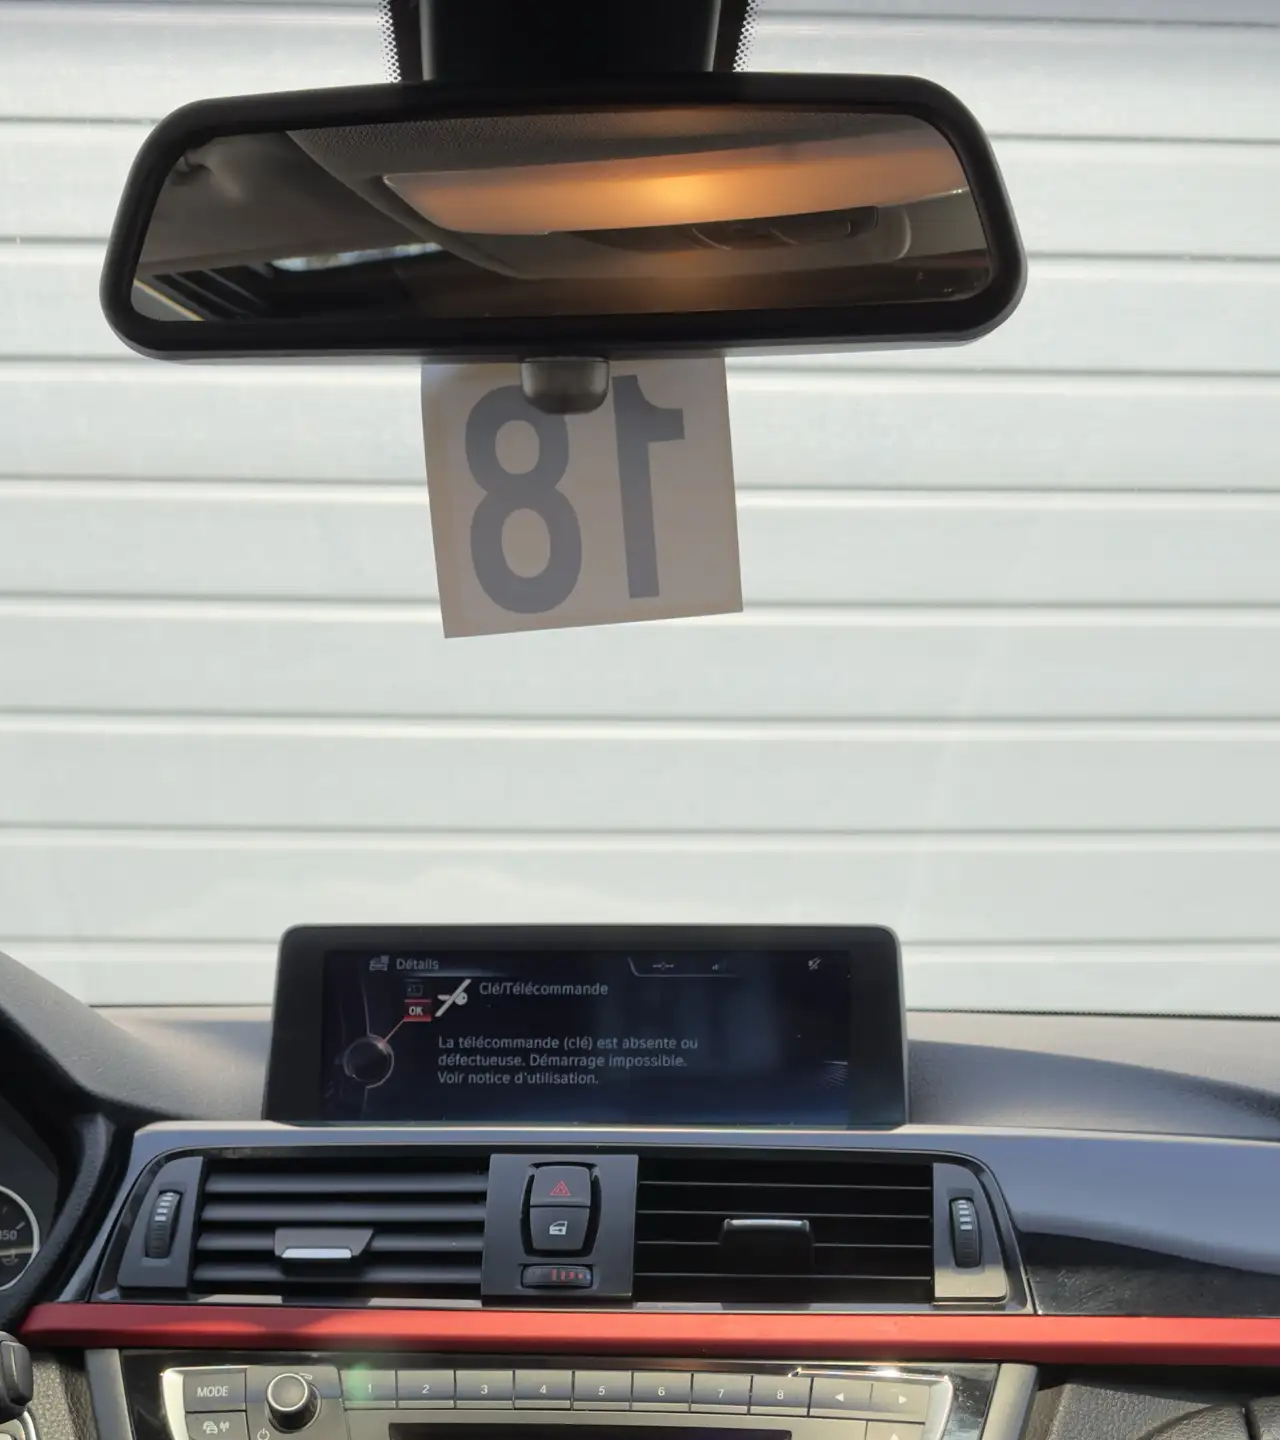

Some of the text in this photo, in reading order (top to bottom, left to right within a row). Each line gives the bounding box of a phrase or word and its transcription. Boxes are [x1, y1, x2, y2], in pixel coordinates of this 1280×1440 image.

[396, 957, 440, 970] Détails
[479, 982, 608, 996] Clé/Télécommande
[408, 1006, 423, 1016] OK
[438, 1036, 698, 1051] La télécommande (clé) est absente ou
[438, 1054, 687, 1070] défectueuse. Démarrage impossible.
[438, 1072, 599, 1085] Voir notice d'utilisation.
[197, 1385, 229, 1398] MODE
[421, 1383, 430, 1394] 2
[480, 1384, 489, 1395] 3
[539, 1384, 548, 1395] 4
[598, 1386, 606, 1396] 5
[658, 1386, 665, 1397] 6
[717, 1388, 725, 1399] 7
[777, 1389, 784, 1400] 8
